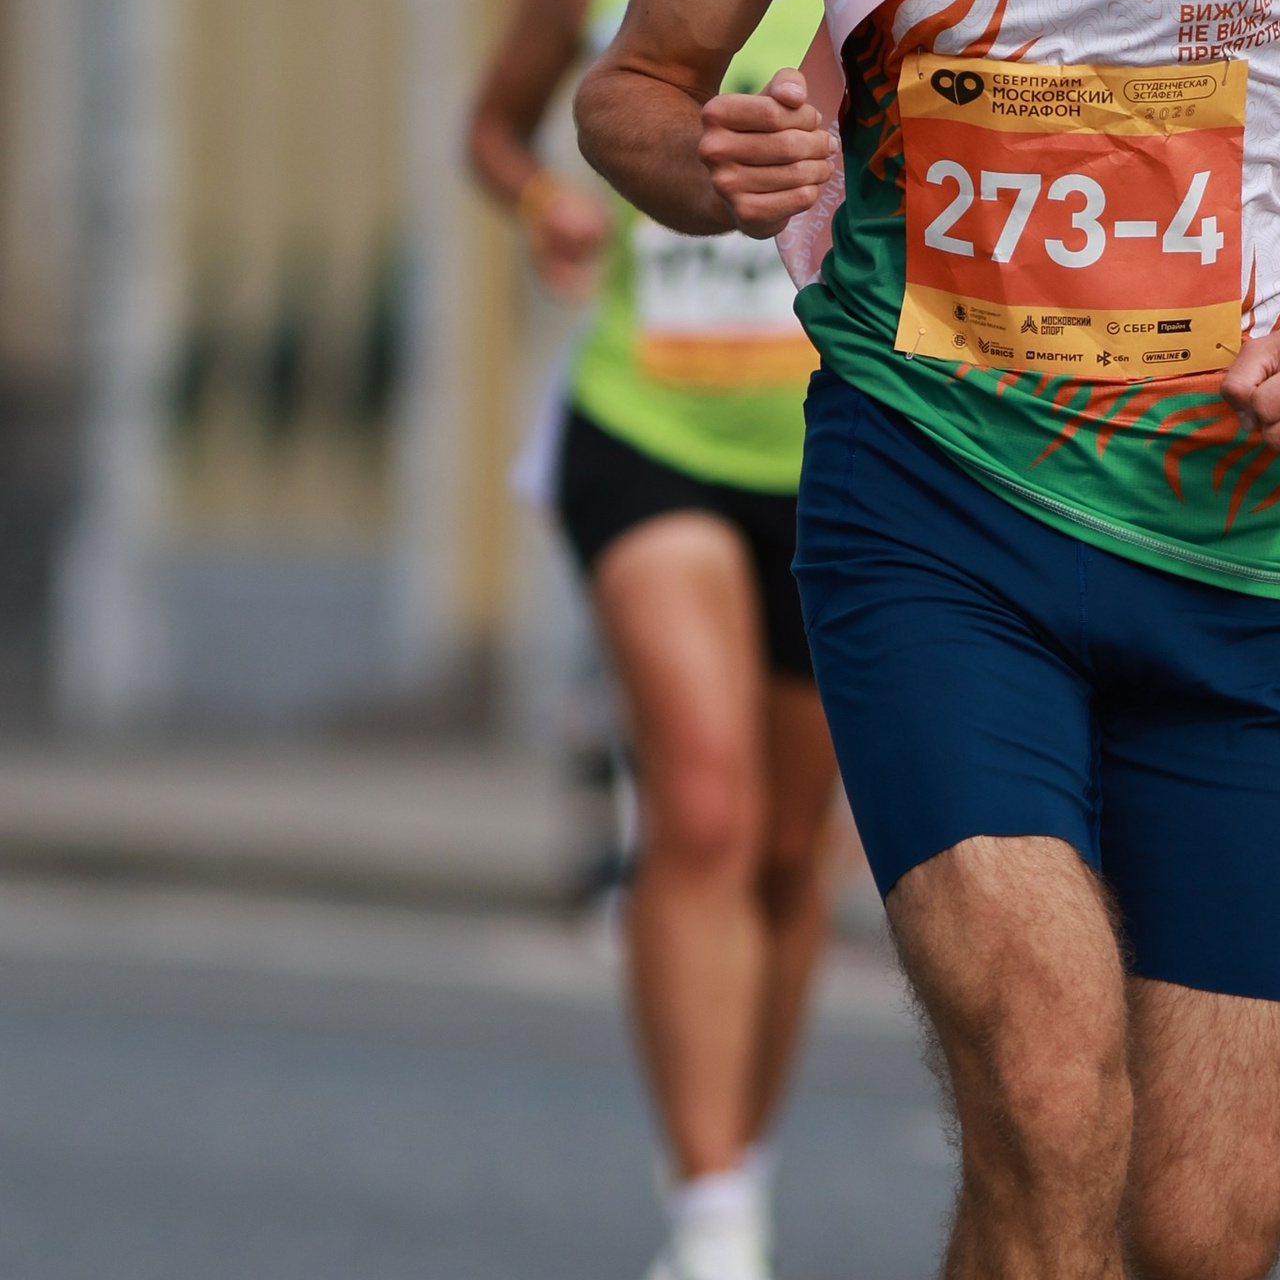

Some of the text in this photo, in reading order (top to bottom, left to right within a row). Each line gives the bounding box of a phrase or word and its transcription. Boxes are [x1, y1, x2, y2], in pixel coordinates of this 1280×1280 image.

[1180, 0, 1249, 23] ВИЖУ
[1178, 24, 1209, 43] НЕ
[993, 73, 1081, 87] СБЕРПРАЙМ
[1133, 78, 1208, 91] СТУДЕНЧЕСКАЯ
[993, 86, 1113, 104] МОСКОВСКИЙ
[1133, 90, 1183, 100] ЭСТАФЕТА
[992, 101, 1081, 117] МАРАФОН
[1144, 104, 1196, 120] 2026
[924, 159, 1224, 268] 273-4
[1041, 315, 1091, 326] МОСКОВСКИЙ
[1041, 326, 1065, 336] СПОРТ
[1123, 322, 1186, 333] СБЕР Прайм
[990, 348, 1014, 358] BRICS
[1146, 352, 1180, 361] WINLINE
